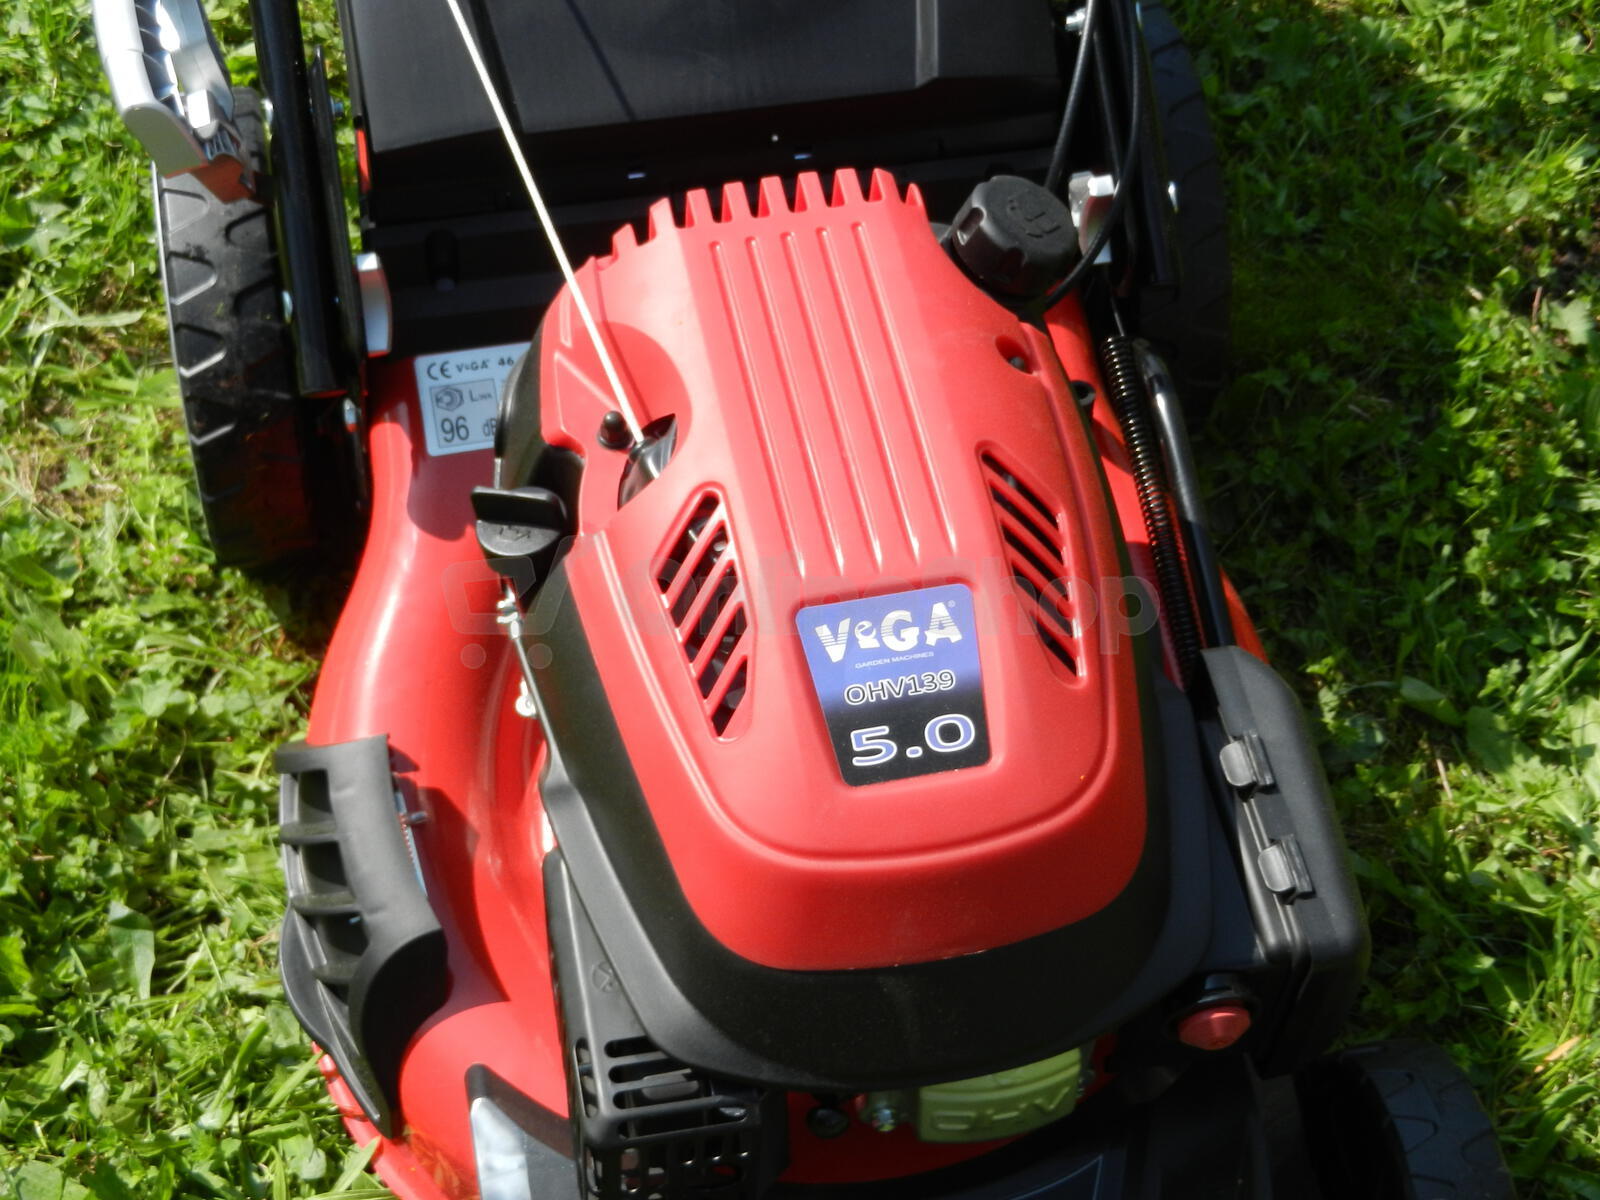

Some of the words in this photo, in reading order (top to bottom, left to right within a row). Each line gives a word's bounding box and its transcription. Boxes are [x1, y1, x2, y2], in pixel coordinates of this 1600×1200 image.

[440, 415, 470, 444] 96
[855, 657, 890, 669] GARDEN
[892, 651, 935, 663] MACHINES
[844, 670, 955, 705] OHV139
[850, 713, 975, 766] 5.0
[934, 1086, 1071, 1130] OHV
